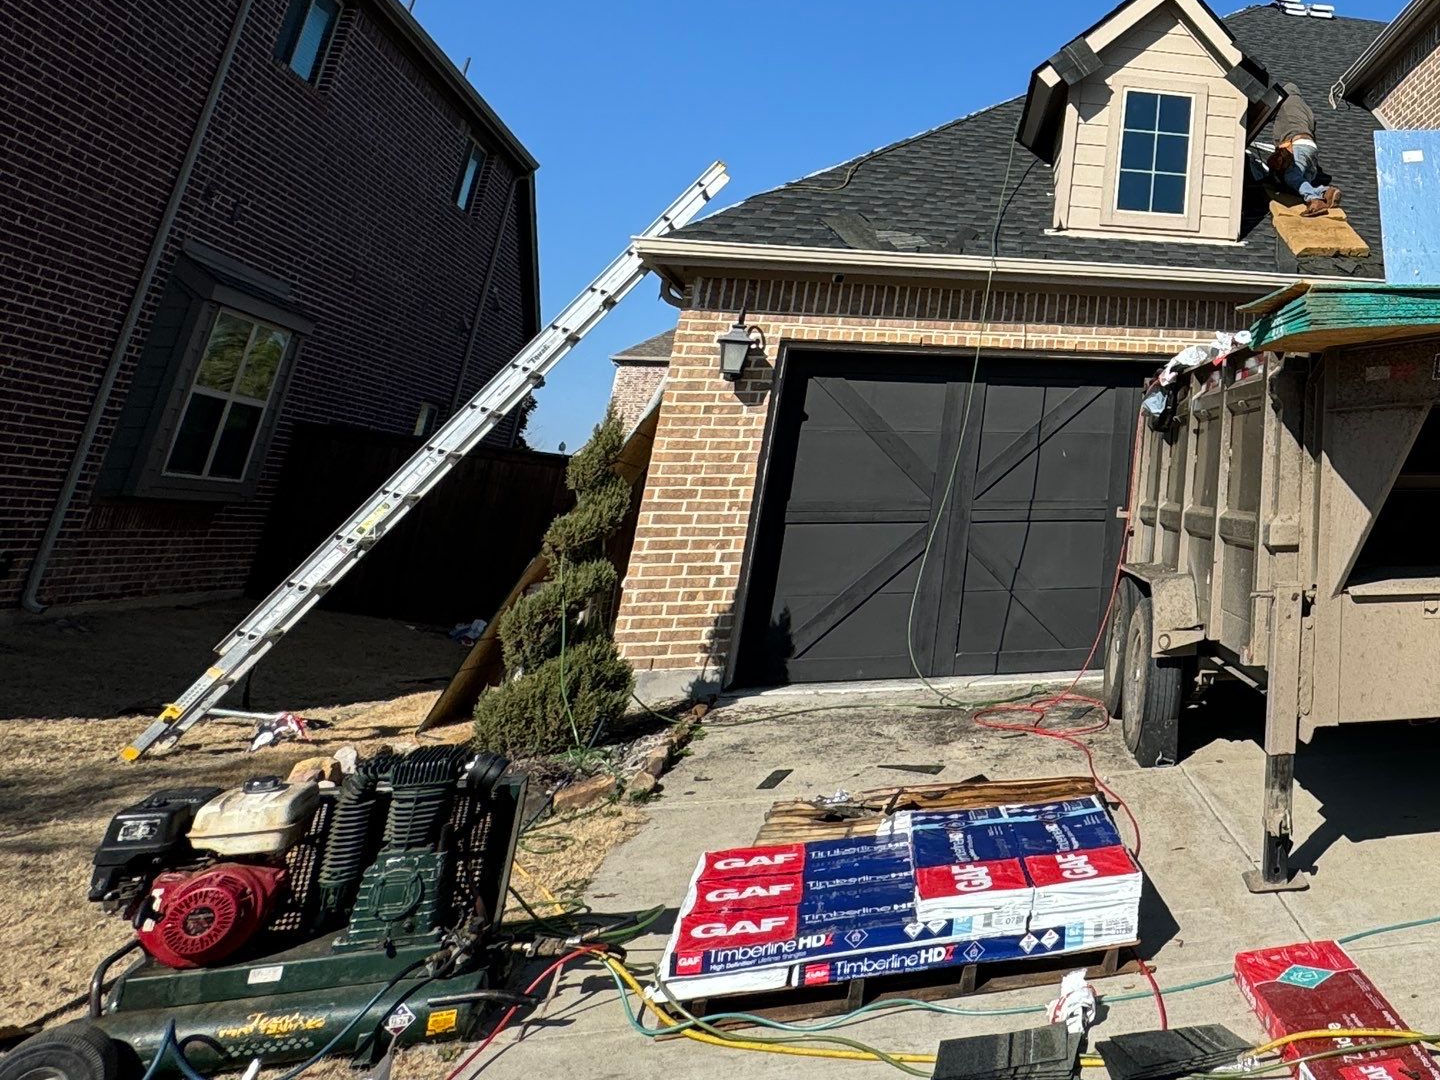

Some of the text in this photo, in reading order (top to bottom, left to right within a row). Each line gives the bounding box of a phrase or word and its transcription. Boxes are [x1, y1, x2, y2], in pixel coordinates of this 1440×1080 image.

[713, 852, 799, 870] GAF
[1055, 854, 1099, 878] GAF
[951, 865, 993, 891] GAF
[705, 883, 795, 902] GAF
[690, 916, 789, 939] GAF
[679, 956, 702, 967] GAF
[709, 940, 797, 963] Timberline
[835, 953, 918, 976] Timberline
